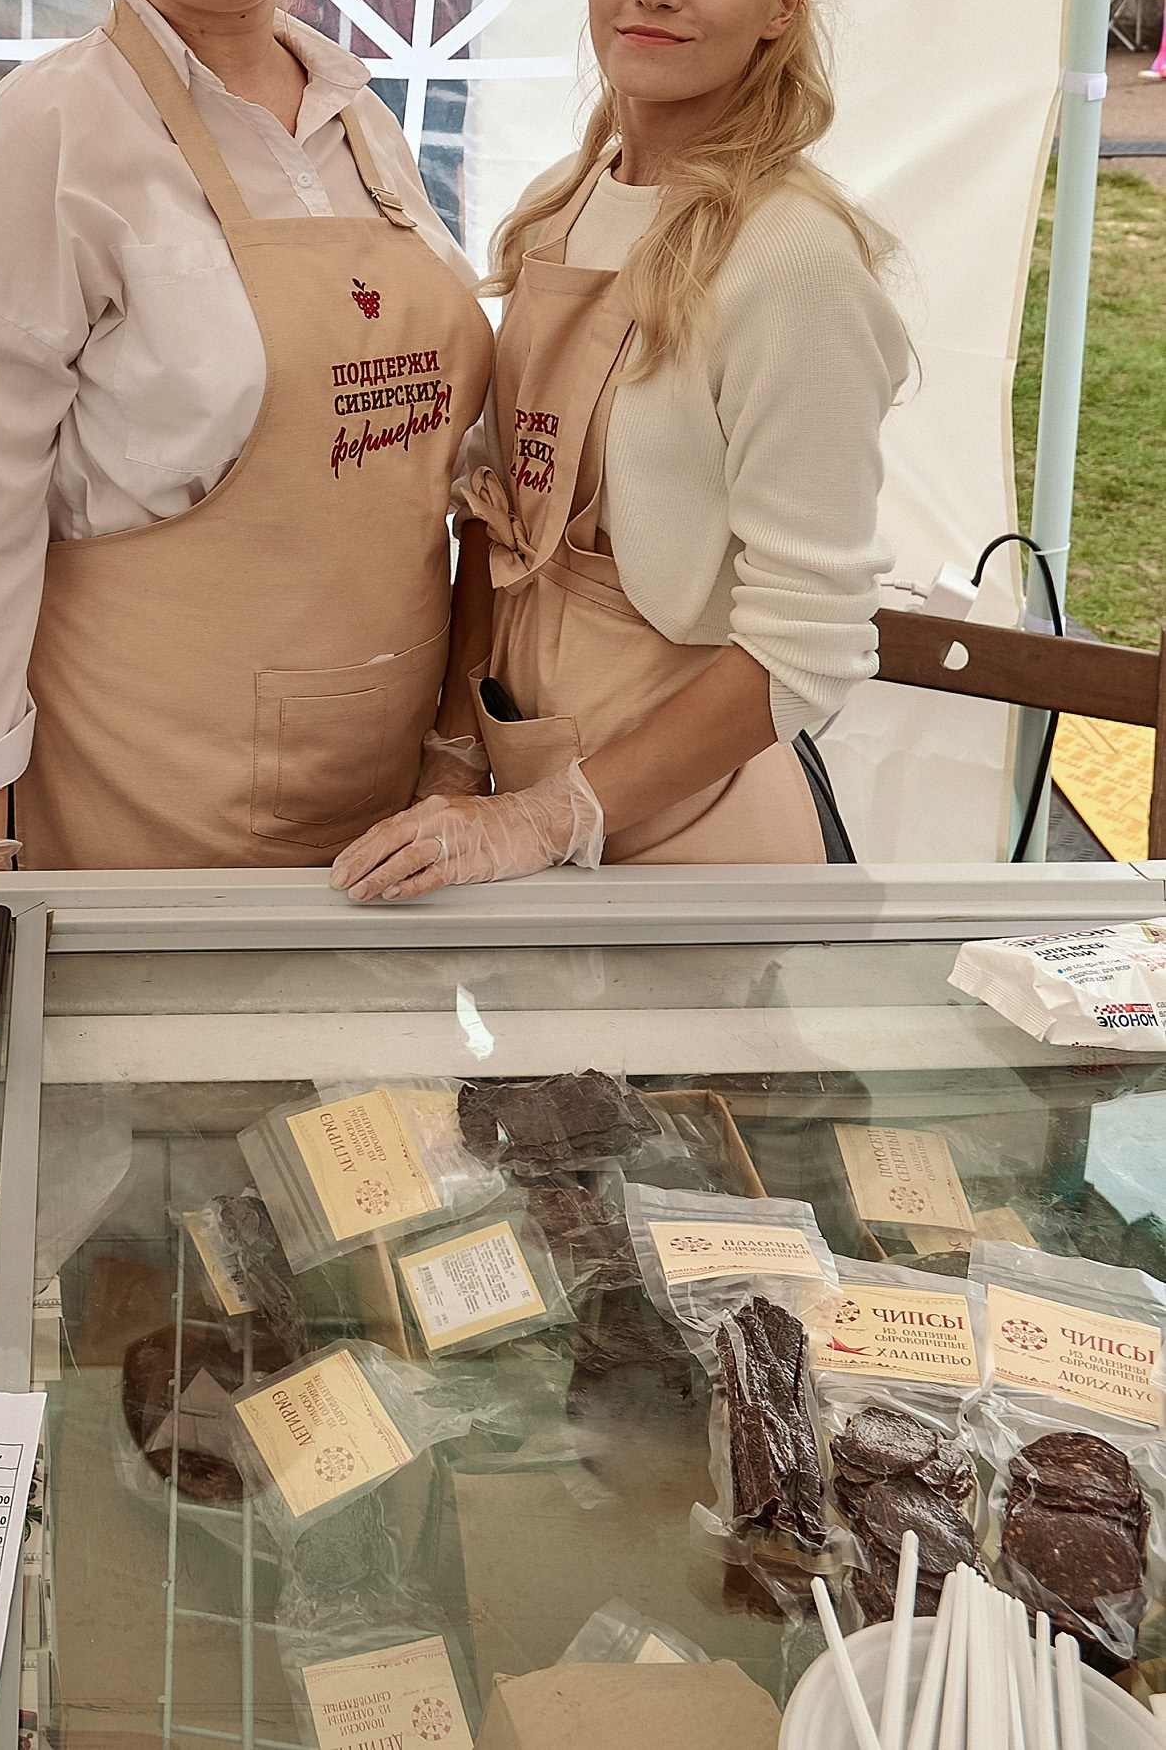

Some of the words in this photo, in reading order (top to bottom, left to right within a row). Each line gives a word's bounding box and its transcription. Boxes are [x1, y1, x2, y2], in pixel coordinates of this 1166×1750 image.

[331, 350, 440, 386] ПОДДЕРЖИ
[334, 380, 442, 416] СИБИРСКИХ
[330, 384, 453, 479] фермеров!
[1097, 1013, 1159, 1029] ЭКОНОМ
[320, 1113, 358, 1172] ДЕГИРМЭ
[342, 1119, 365, 1157] ПОЛОСКИ
[348, 1109, 370, 1148] ОЛЕНИНЫ
[367, 1150, 377, 1161] ИЗ
[867, 1129, 894, 1178] ПОЛОСКИ
[883, 1129, 911, 1182] СЕВЕРНЫЕ
[723, 1239, 806, 1250] ПАЛОЧКИ
[871, 1308, 965, 1330] ЧИПСЫ
[883, 1327, 897, 1335] ИЗ
[902, 1328, 958, 1341] ОЛЕНИНЫ
[874, 1334, 969, 1351] СЫРОКОПЧЕНЫЕ
[876, 1347, 972, 1367] ХАЛАПЕНЬО
[1060, 1327, 1155, 1365] ЧИПСЫ
[1060, 1355, 1149, 1385] СЫРОКОПЧЕНЫ
[1069, 1349, 1083, 1359] ИЗ
[1089, 1354, 1146, 1376] ОЛЕНИНЫ
[298, 1392, 323, 1427] ПОЛОСКИ
[304, 1380, 329, 1416] ОЛЕНИНЫ
[272, 1390, 315, 1446] ДЕГИРМЭ
[328, 1707, 374, 1726] ОЛЕНИНЫ
[378, 1704, 391, 1714] ИЗ
[340, 1718, 385, 1736] ПОЛОСКИ
